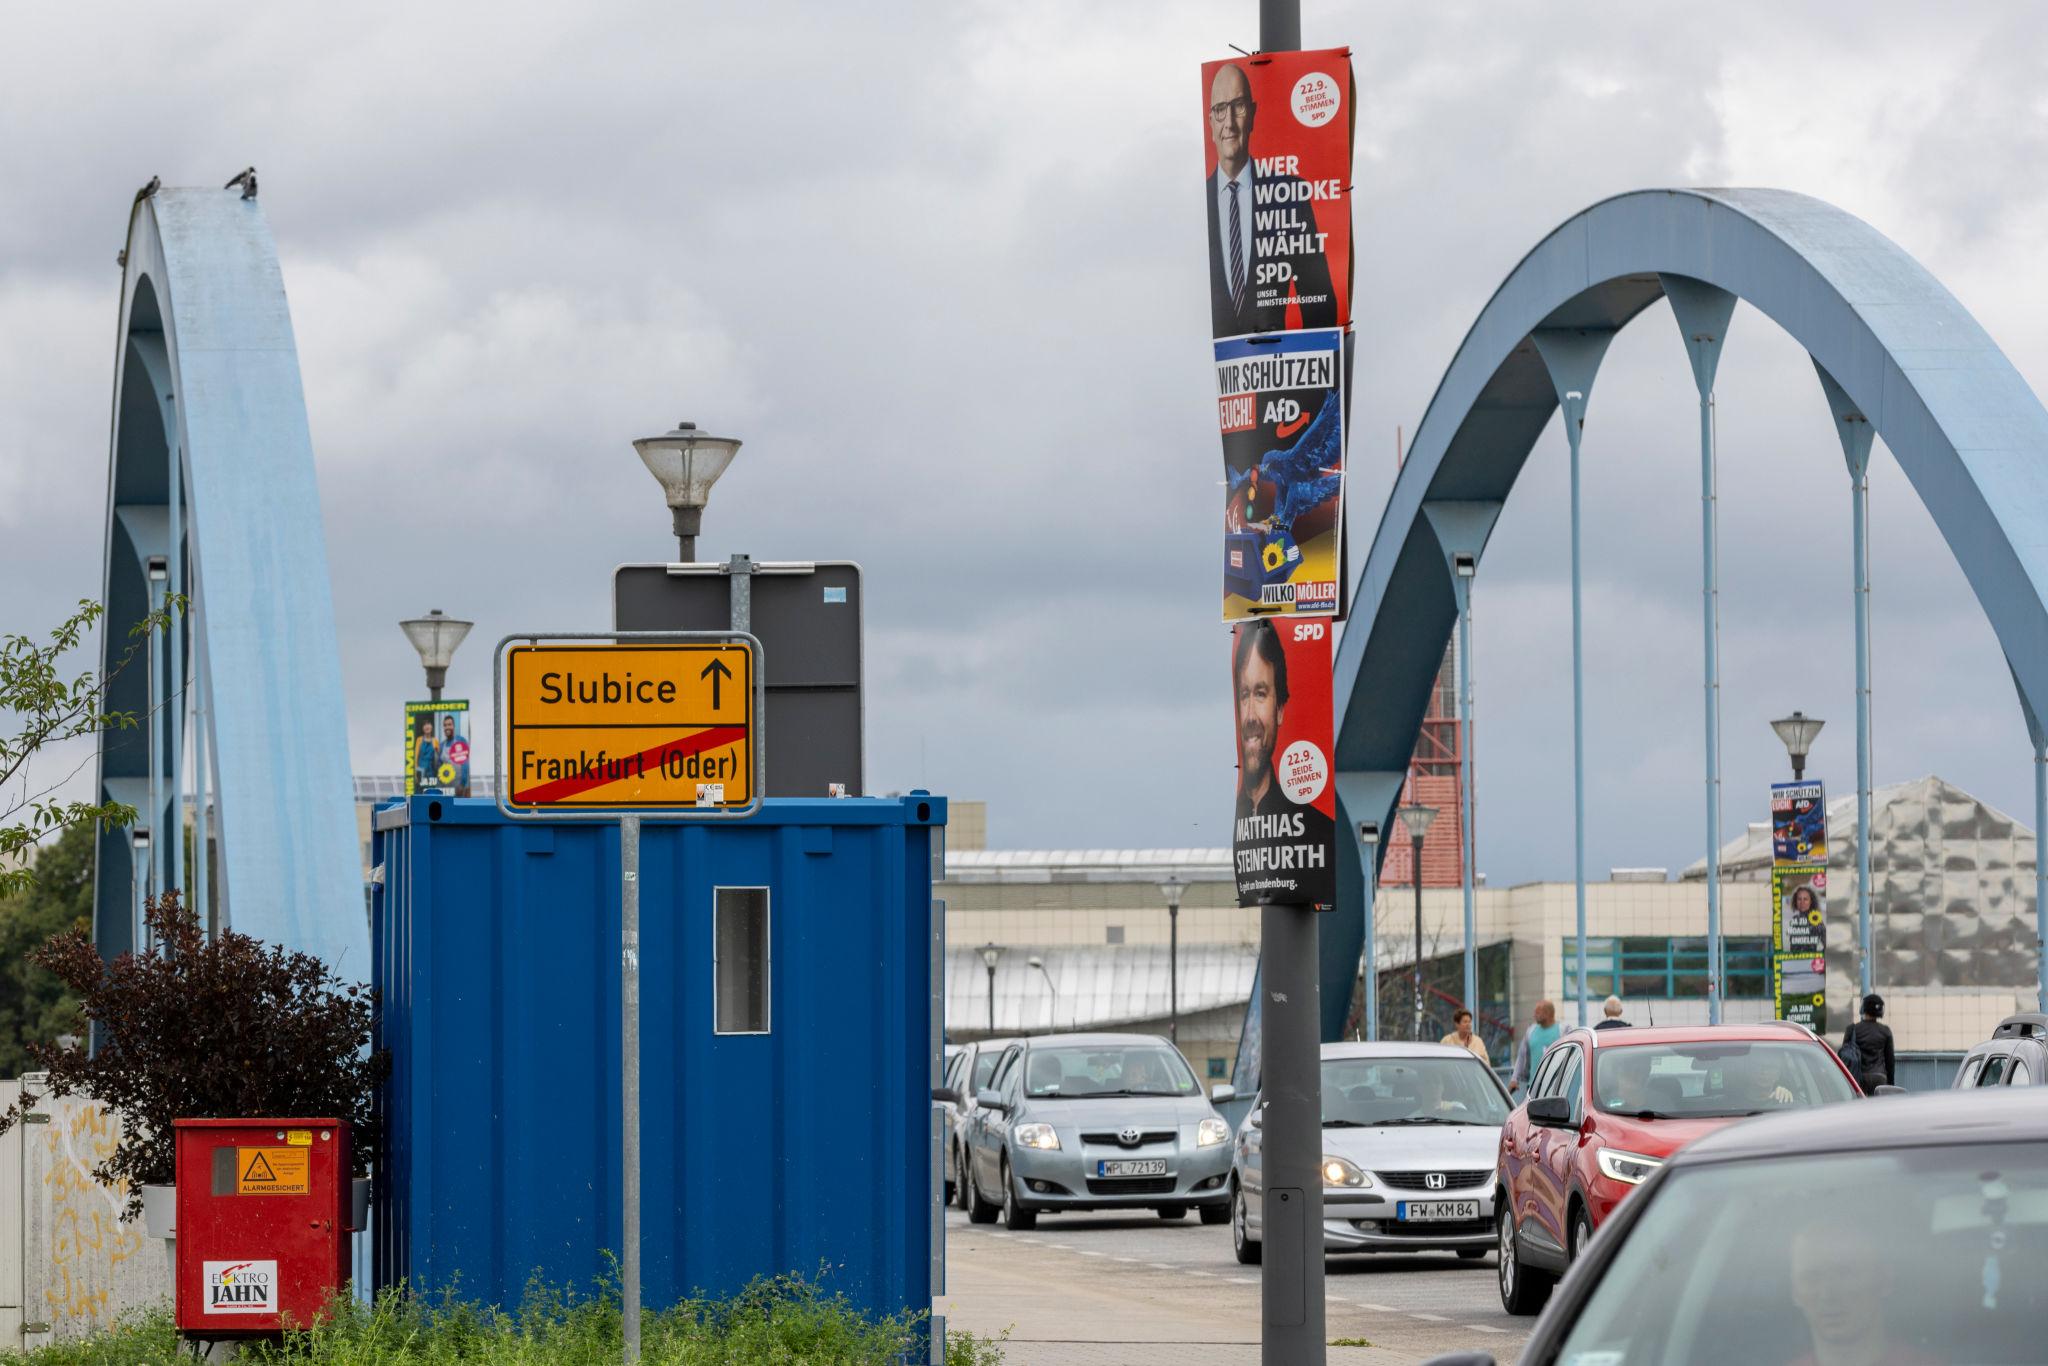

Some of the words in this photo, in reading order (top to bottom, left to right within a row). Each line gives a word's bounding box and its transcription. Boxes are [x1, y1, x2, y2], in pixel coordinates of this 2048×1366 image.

[1301, 80, 1327, 95] 22.9.
[1305, 92, 1327, 103] BEIDE
[1300, 98, 1335, 113] STIMMEN
[1311, 111, 1326, 121] SPD
[1254, 155, 1299, 178] WER
[1255, 179, 1341, 205] WOIDKE
[1255, 208, 1307, 232] WILL,
[1255, 230, 1328, 258] WÄHLT
[1256, 262, 1298, 285] SPD.
[1256, 289, 1277, 299] UNSER
[1256, 294, 1327, 308] MINISTERPRÄSIDENT
[1218, 365, 1240, 394] WIR
[1242, 354, 1330, 391] SCHÜTZEN
[1219, 396, 1253, 430] EUCH!
[1263, 398, 1300, 424] AfD
[1263, 585, 1294, 603] WILKO
[1297, 581, 1335, 600] MÖLLER
[1293, 623, 1324, 642] SPD
[540, 672, 677, 704] Slubice
[406, 713, 414, 776] MUT
[521, 750, 645, 780] Frankfurt
[660, 747, 737, 781] (Oder)
[1287, 750, 1314, 766] 22.9.
[1287, 771, 1322, 787] STIMMEN
[1292, 764, 1313, 776] BEIDE
[1298, 787, 1312, 796] SPD
[1236, 812, 1305, 842] MATTHIAS
[1236, 844, 1325, 874] STEINFURTH
[1772, 874, 1782, 921] MUT
[1105, 1162, 1127, 1175] WPL
[1130, 1161, 1164, 1174] 72139
[1410, 1204, 1428, 1217] FW
[1436, 1203, 1454, 1217] KM
[1457, 1203, 1473, 1216] 84
[211, 1285, 268, 1305] JAHN
